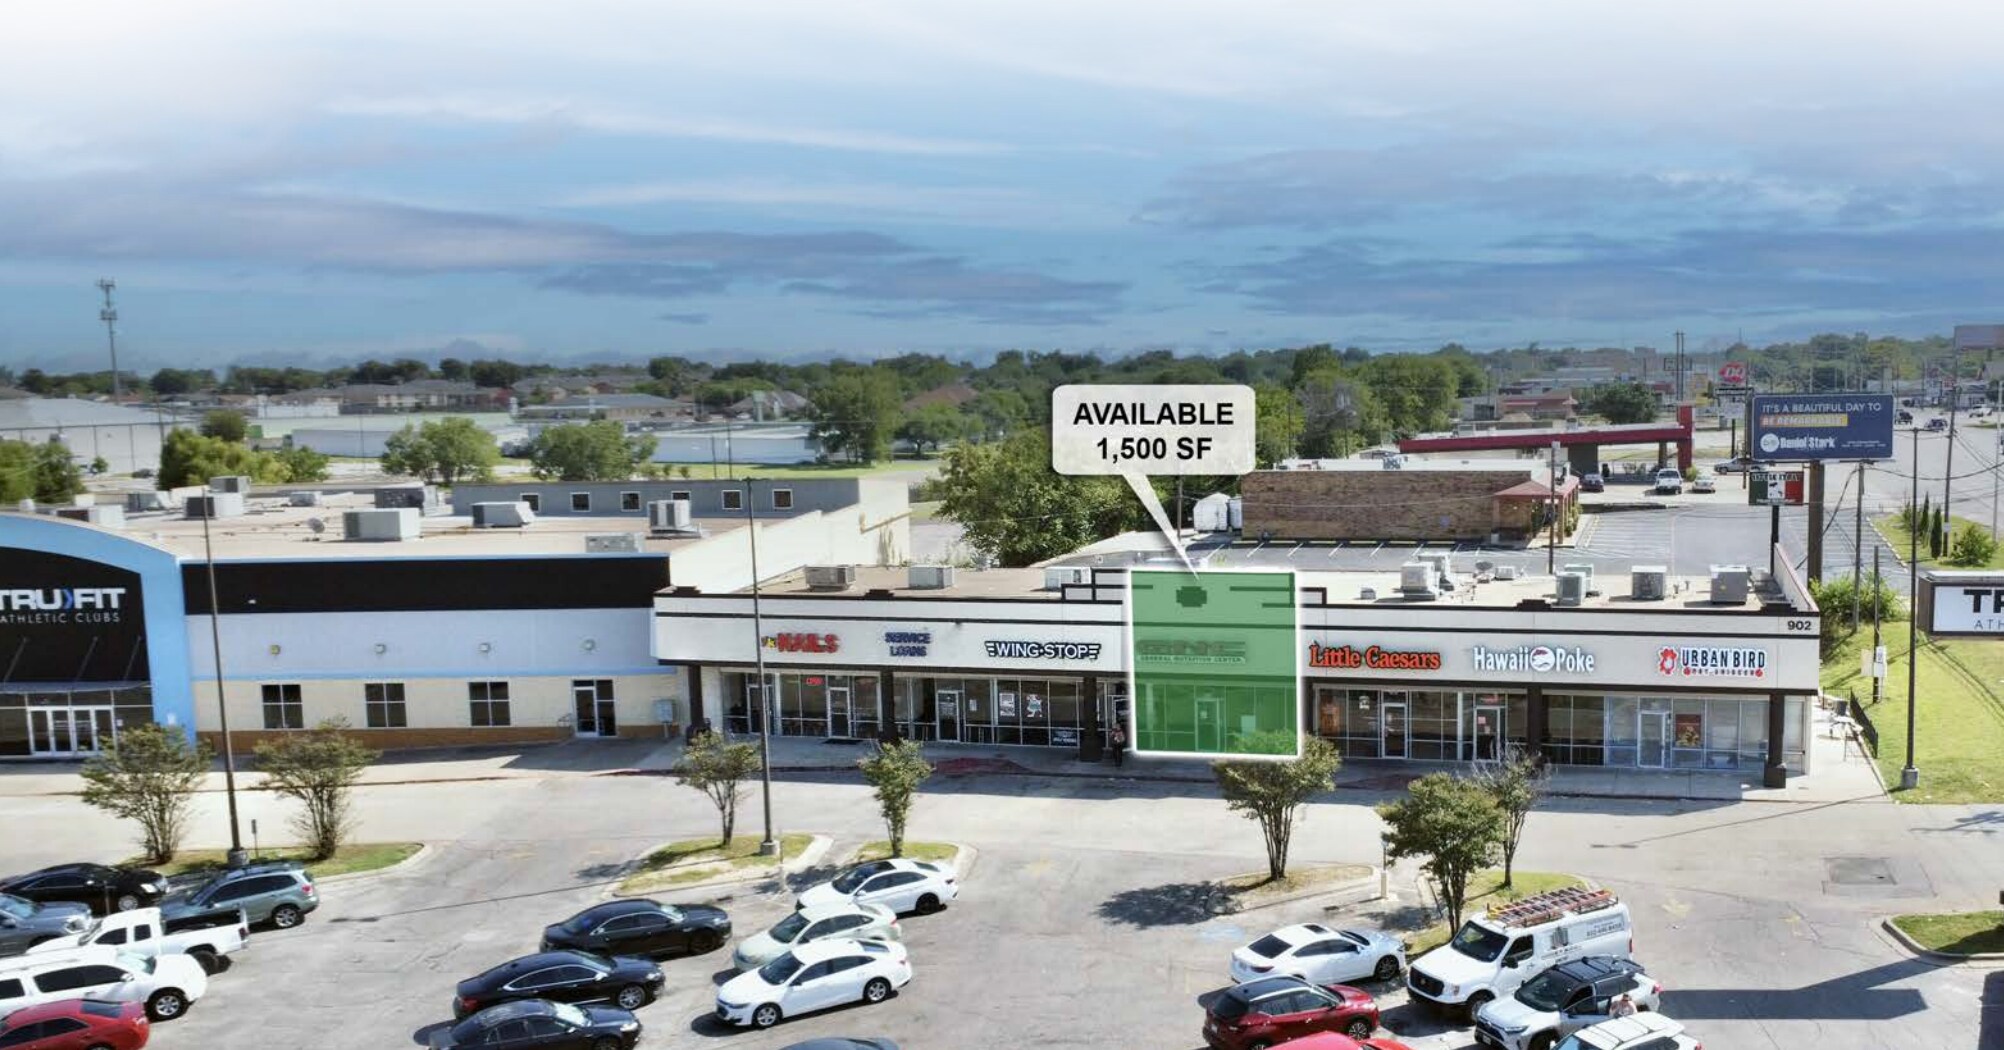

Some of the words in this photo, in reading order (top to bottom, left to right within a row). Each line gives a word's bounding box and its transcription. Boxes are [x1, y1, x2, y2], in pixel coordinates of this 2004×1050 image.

[1762, 405, 1780, 413] IT'S
[1781, 404, 1790, 412] A
[1792, 403, 1842, 413] BEAUTIFUL
[1846, 402, 1865, 412] DAY
[1869, 402, 1881, 411] TO
[0, 613, 67, 624] ATHLETIC
[75, 612, 120, 623] CLUBS
[1787, 620, 1812, 631] 902
[777, 633, 840, 653] NAILS
[1309, 644, 1361, 668] Little
[1365, 645, 1441, 669] Caesars
[1473, 646, 1529, 671] Hawaii
[1555, 647, 1595, 671] Poke
[1682, 650, 1728, 667] URBAN
[1733, 651, 1765, 668] BIRD
